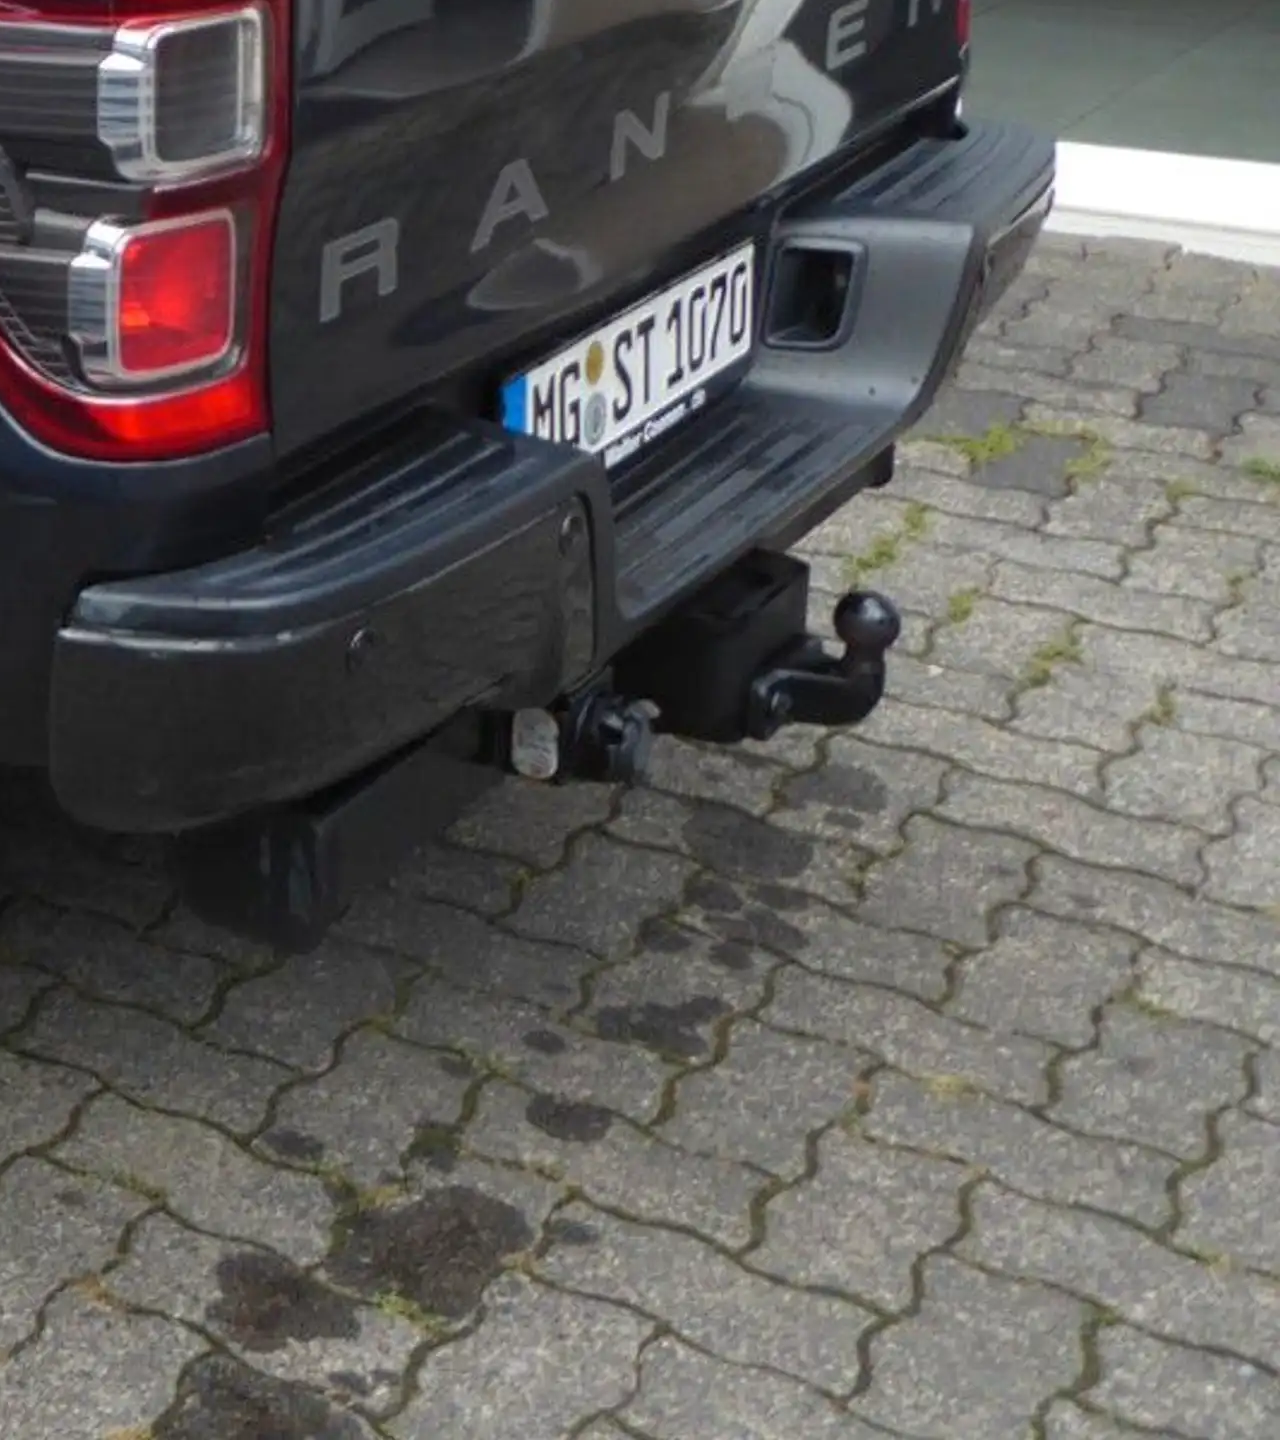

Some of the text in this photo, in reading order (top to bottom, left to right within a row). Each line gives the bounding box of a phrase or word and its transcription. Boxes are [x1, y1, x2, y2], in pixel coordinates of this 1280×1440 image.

[533, 361, 582, 445] MG
[612, 314, 656, 423] ST
[666, 261, 747, 389] 1070
